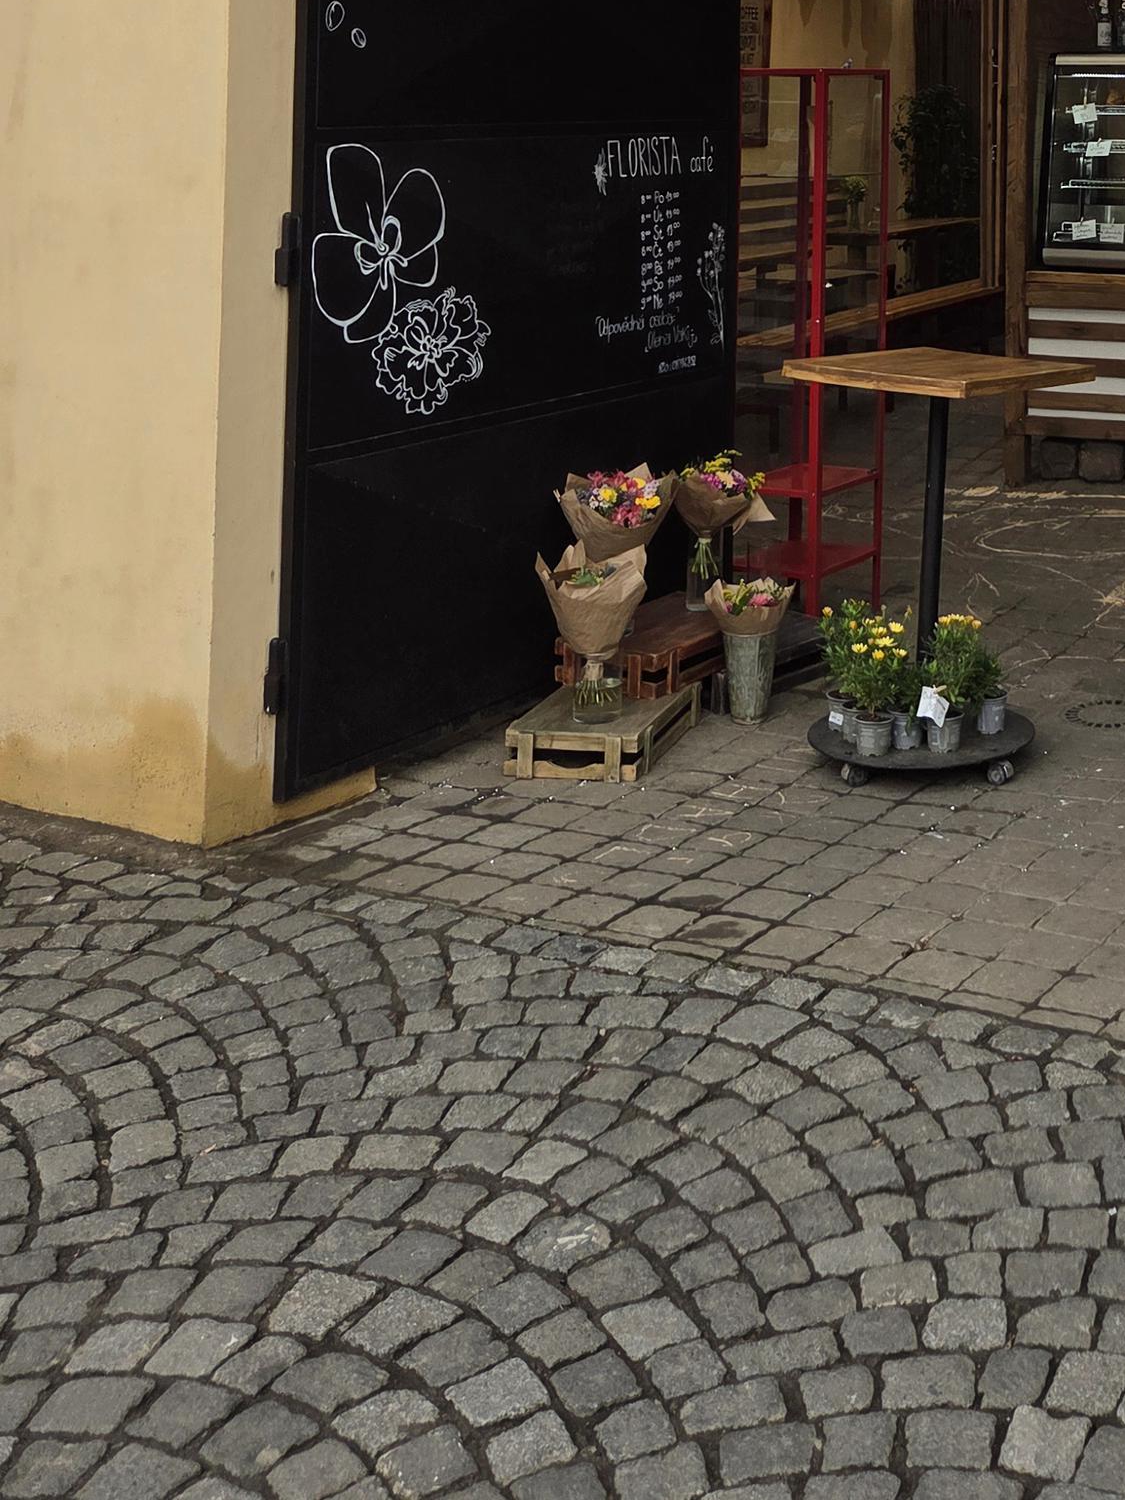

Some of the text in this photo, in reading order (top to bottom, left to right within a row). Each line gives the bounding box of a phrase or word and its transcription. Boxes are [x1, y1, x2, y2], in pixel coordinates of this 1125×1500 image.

[607, 136, 714, 178] FLORISTA café
[654, 190, 665, 204] Po
[652, 275, 664, 292] So
